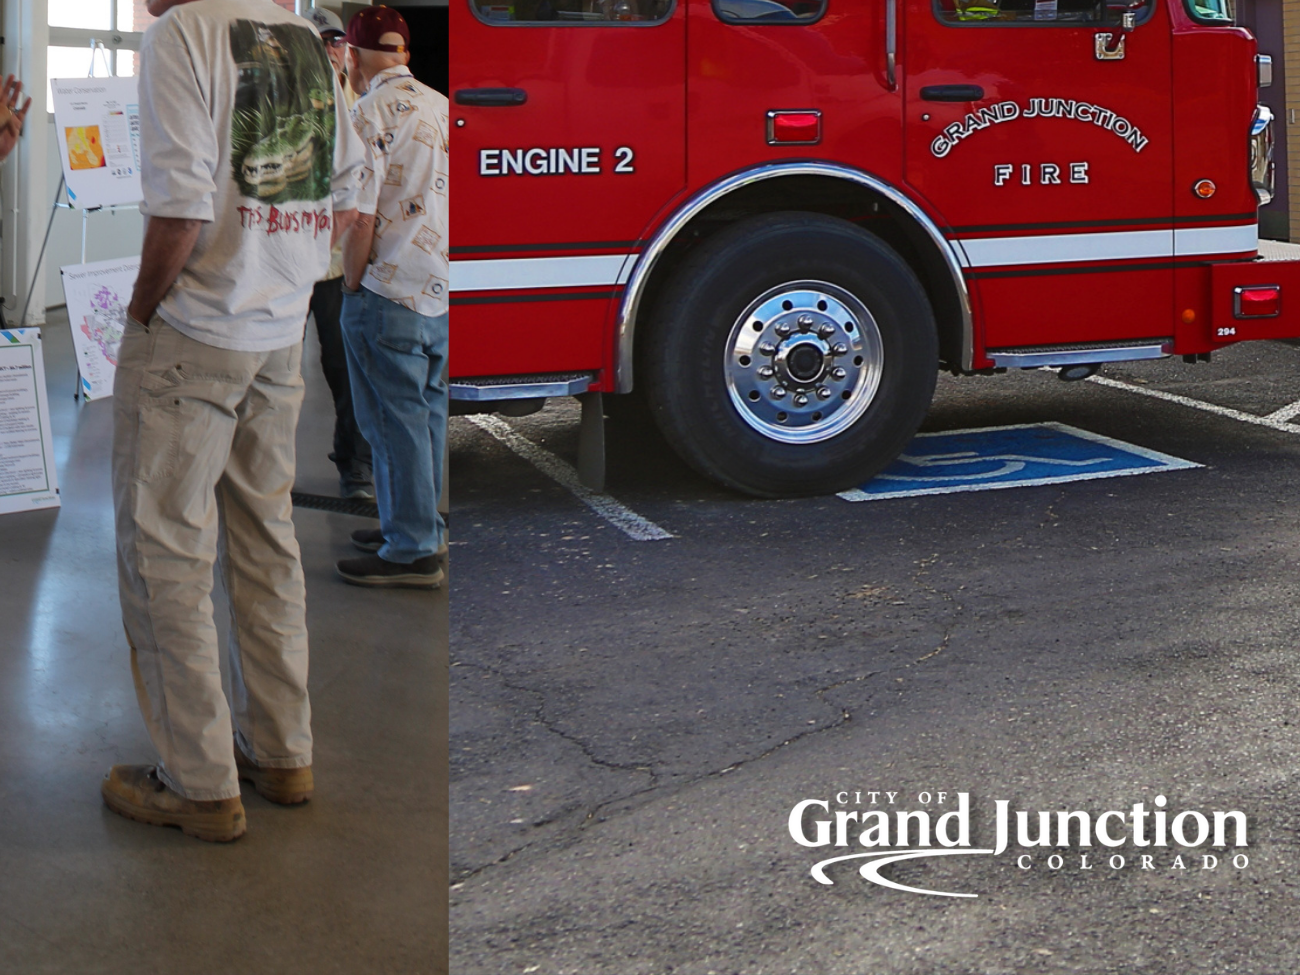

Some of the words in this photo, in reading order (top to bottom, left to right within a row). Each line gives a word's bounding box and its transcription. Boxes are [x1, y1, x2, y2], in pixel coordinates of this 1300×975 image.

[930, 101, 1020, 158] GRAND
[1023, 98, 1149, 152] JUNCTION
[479, 147, 600, 175] ENGINE
[614, 146, 634, 173] 2
[994, 162, 1089, 186] FIRE
[1217, 327, 1236, 336] 294
